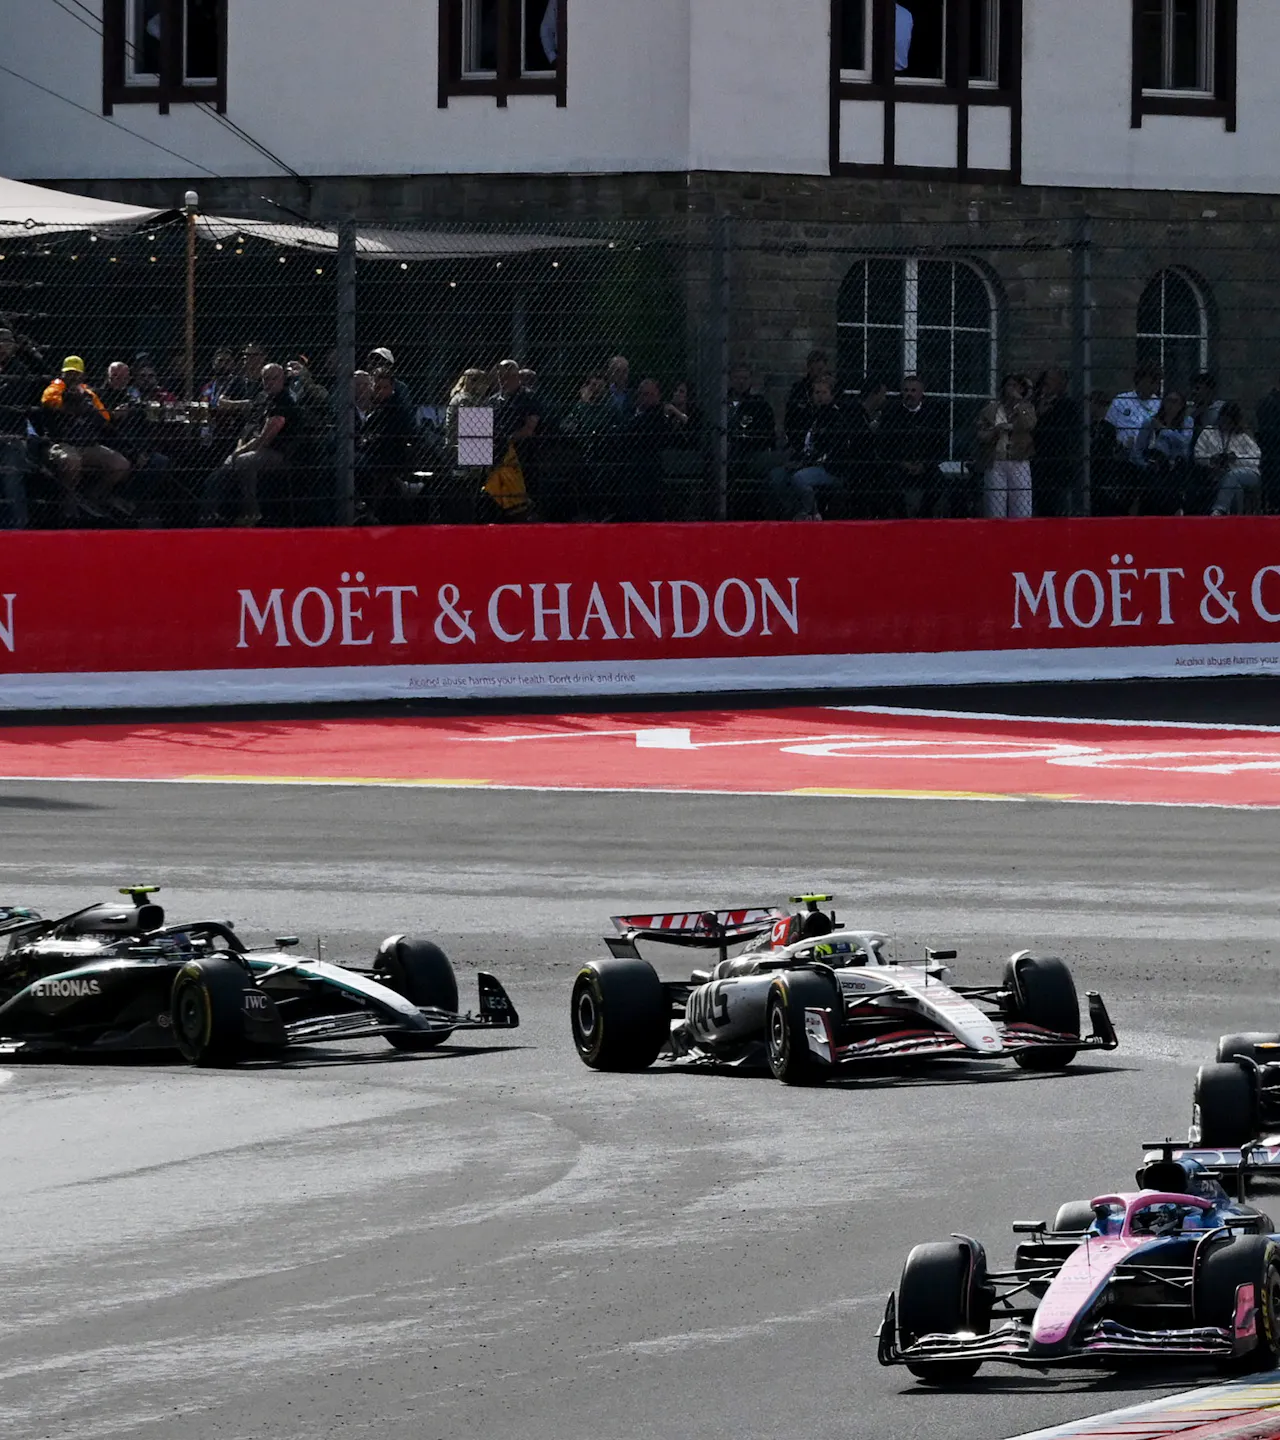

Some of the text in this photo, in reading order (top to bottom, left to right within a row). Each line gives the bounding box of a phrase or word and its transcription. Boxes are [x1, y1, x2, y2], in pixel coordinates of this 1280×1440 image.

[236, 571, 800, 648] MOËT & CHANDON
[1011, 554, 1185, 629] MOËT
[1200, 565, 1239, 624] &
[31, 979, 102, 997] PETRONAS
[245, 995, 267, 1009] IWC
